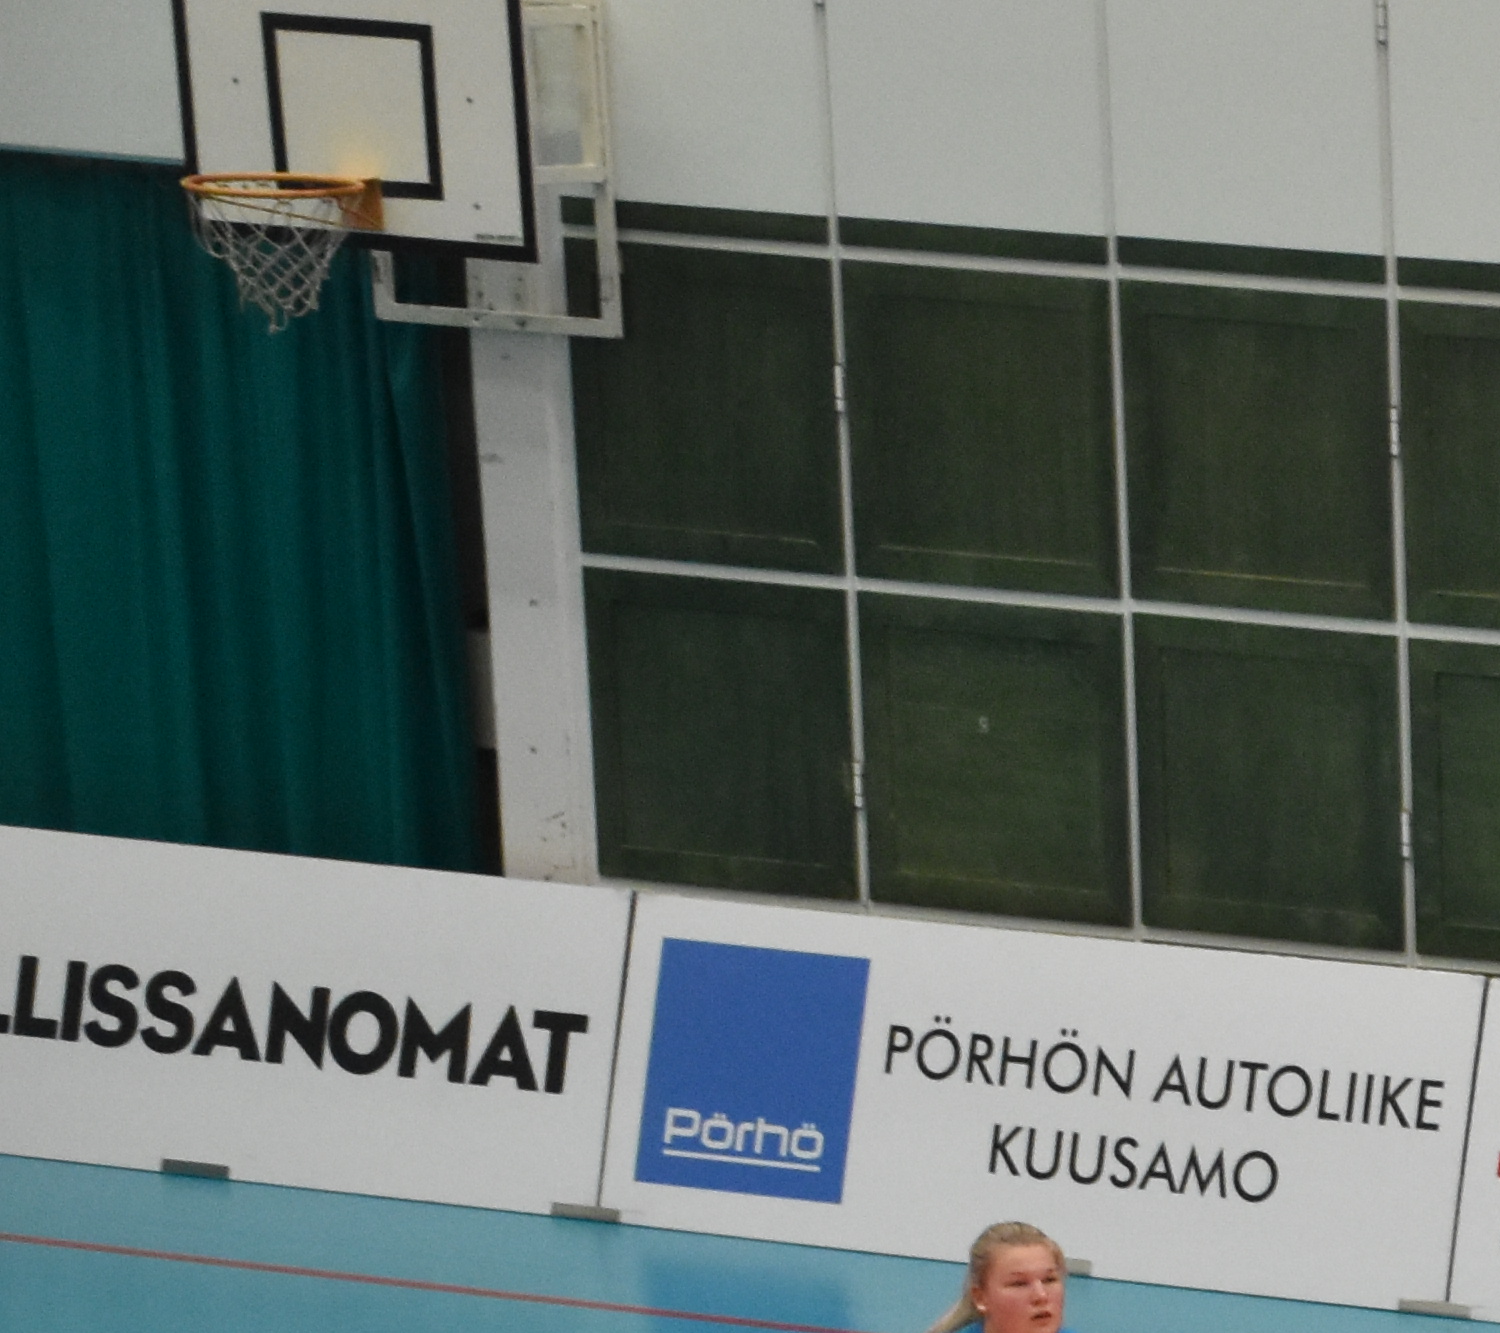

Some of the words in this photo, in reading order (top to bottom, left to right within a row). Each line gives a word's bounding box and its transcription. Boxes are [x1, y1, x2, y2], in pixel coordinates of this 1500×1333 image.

[0, 955, 589, 1095] LISSANOMAT
[884, 1015, 1136, 1098] PÖRHÖN
[1152, 1055, 1444, 1131] AUTOLIIKE
[663, 1107, 824, 1160] Pörhö
[988, 1124, 1278, 1203] KUUSAMO
